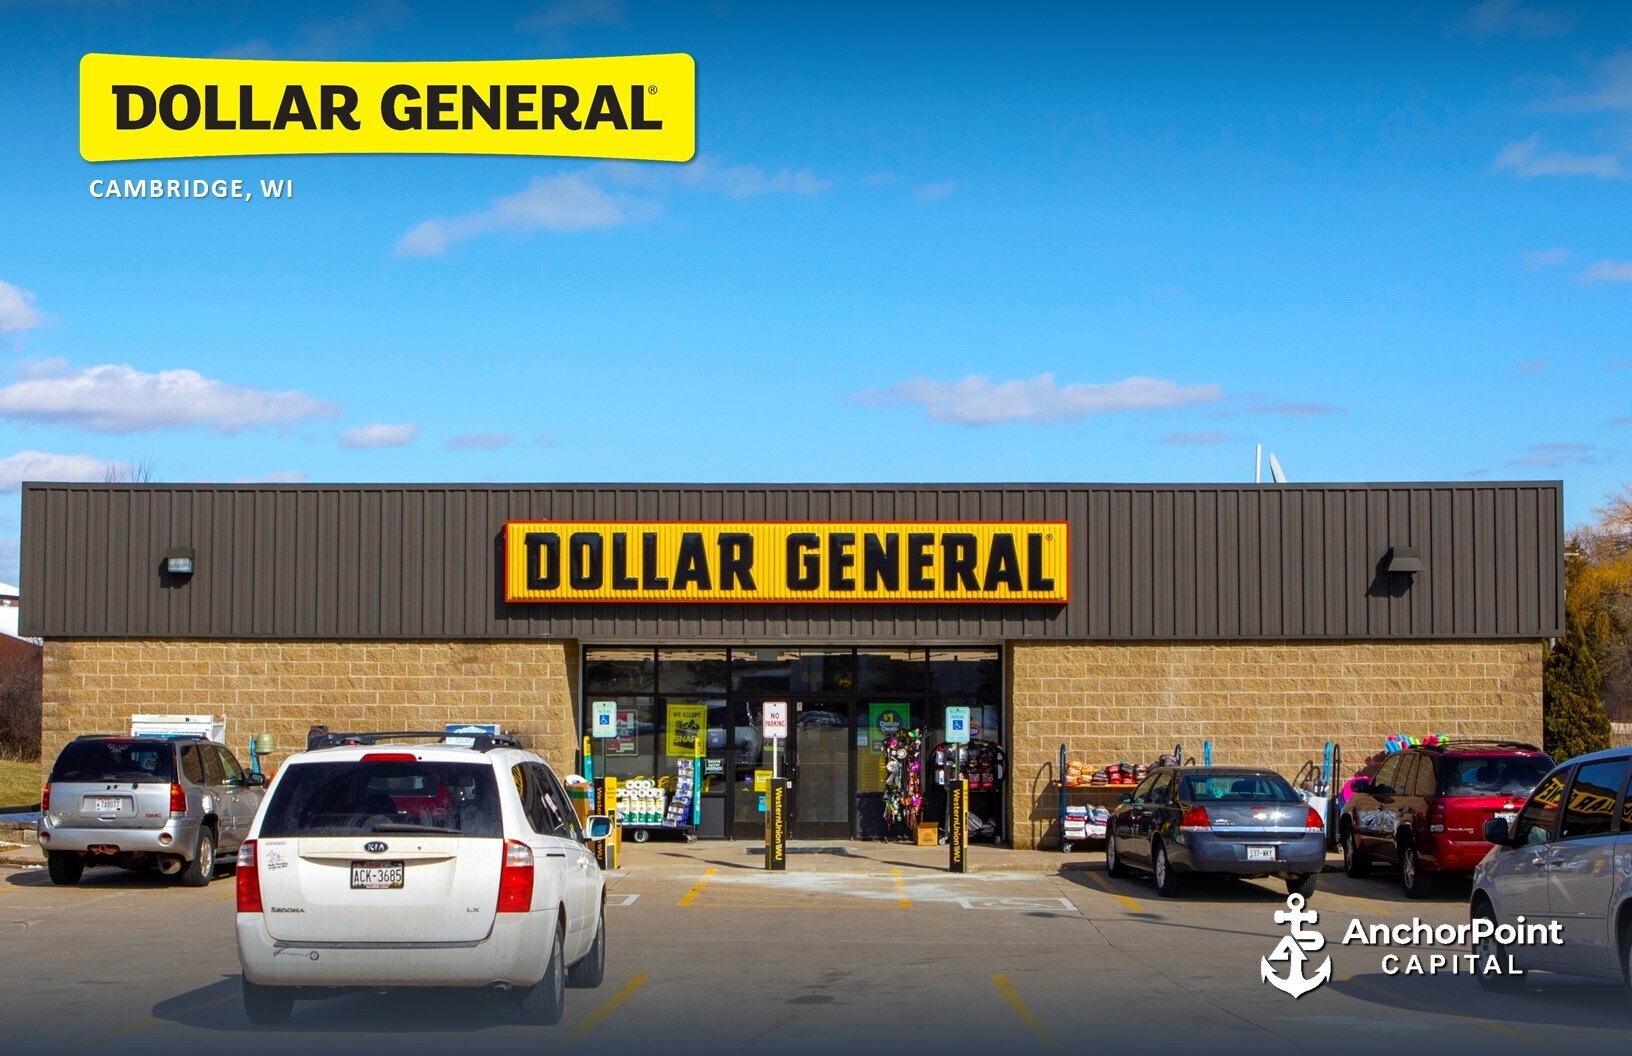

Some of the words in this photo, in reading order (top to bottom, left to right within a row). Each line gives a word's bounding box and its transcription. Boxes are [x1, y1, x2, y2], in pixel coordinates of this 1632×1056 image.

[523, 532, 758, 592] DOLLAR
[786, 532, 1055, 592] GENERAL
[367, 843, 385, 851] KIA
[354, 869, 402, 883] ACK-3685
